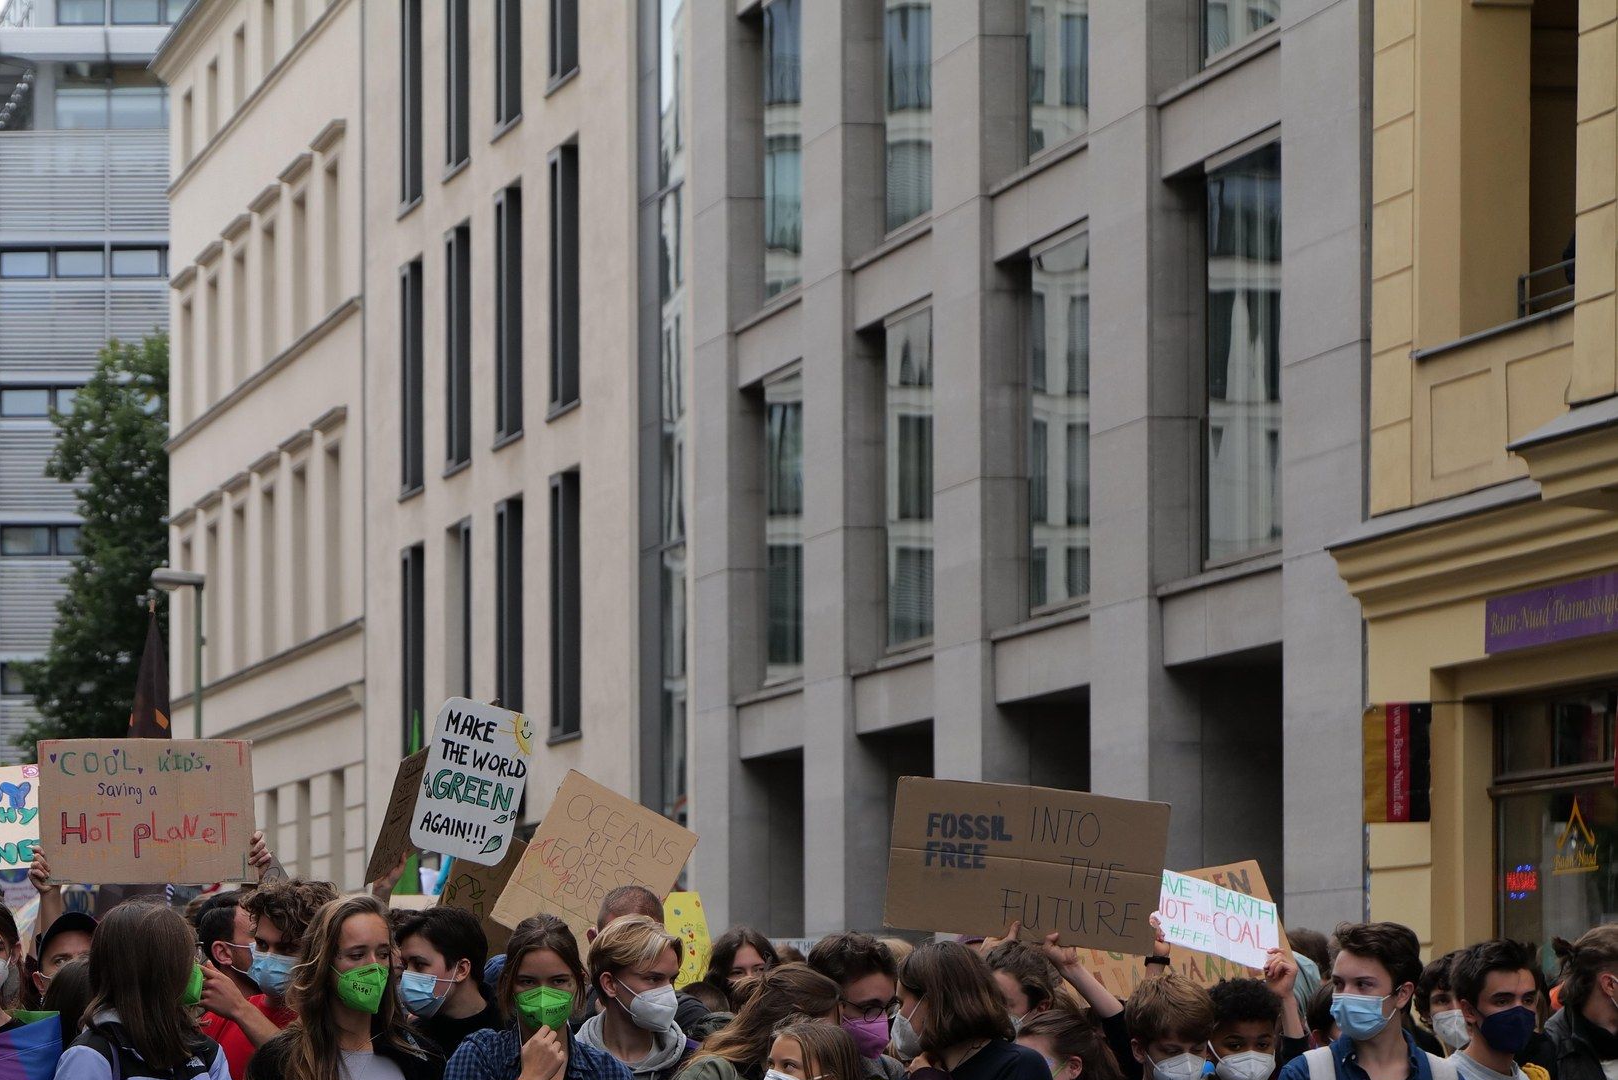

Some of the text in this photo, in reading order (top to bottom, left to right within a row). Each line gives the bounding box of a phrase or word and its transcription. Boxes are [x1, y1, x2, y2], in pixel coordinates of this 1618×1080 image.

[444, 709, 498, 744] MAKE
[60, 750, 206, 776] COOL KIDS
[441, 738, 527, 778] THE WORLD
[149, 786, 158, 796] a
[432, 768, 515, 812] GREEN
[420, 810, 487, 844] AGAIN!!!
[567, 794, 680, 866] OCEANS
[926, 812, 1014, 842] FOSSIL
[1030, 806, 1101, 848] INTO
[549, 837, 655, 890] FOREST
[585, 832, 643, 873] RISE
[925, 841, 989, 870] FREE
[563, 873, 606, 910] BUR
[1060, 855, 1126, 896] THE
[1000, 888, 1141, 938] FUTURE
[1161, 875, 1192, 899] AVE
[1214, 886, 1275, 924] EARTH
[1169, 923, 1213, 945] #FFF
[1213, 911, 1270, 951] COAL
[352, 981, 373, 996] Rise!
